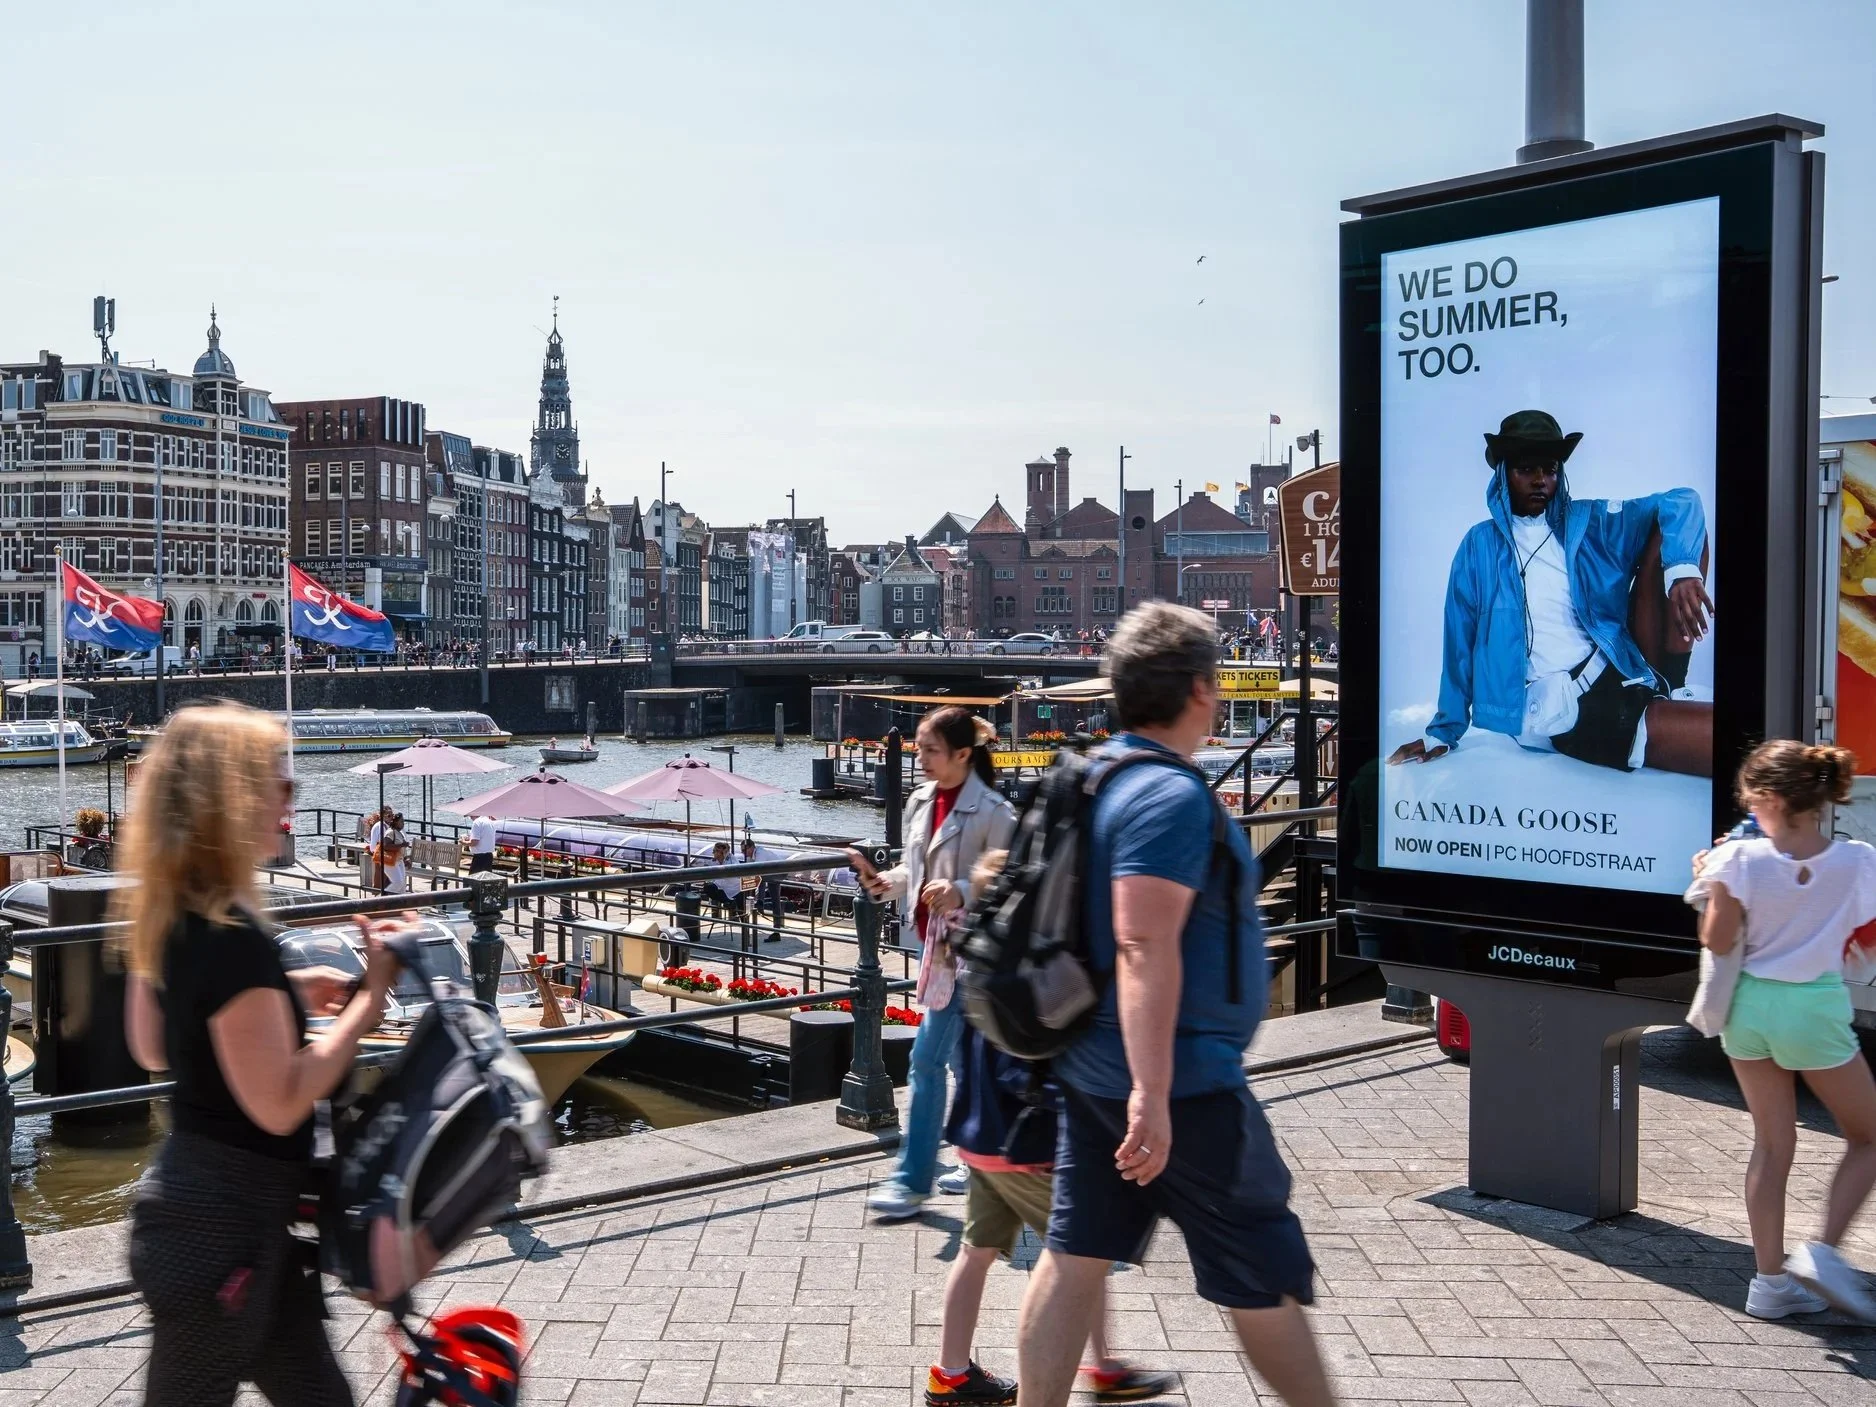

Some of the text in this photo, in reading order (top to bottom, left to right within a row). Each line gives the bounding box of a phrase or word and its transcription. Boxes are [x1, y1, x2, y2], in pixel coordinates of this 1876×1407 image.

[1398, 256, 1518, 302] WE DO
[1398, 291, 1568, 341] SUMMER,
[1398, 343, 1480, 380] TOO.
[1303, 522, 1311, 536] 1
[331, 561, 371, 569] Amterdam
[1311, 578, 1340, 588] ADU
[1239, 671, 1279, 681] TICKETS
[1273, 690, 1300, 698] AMSTERD
[1394, 799, 1618, 835] CANADA GOOSE
[1395, 837, 1433, 854] NOW
[1436, 840, 1482, 858] OPEN
[1494, 845, 1517, 861] PC
[1521, 847, 1657, 873] HOOFDSTRAAT
[1487, 945, 1576, 970] JCDecaux
